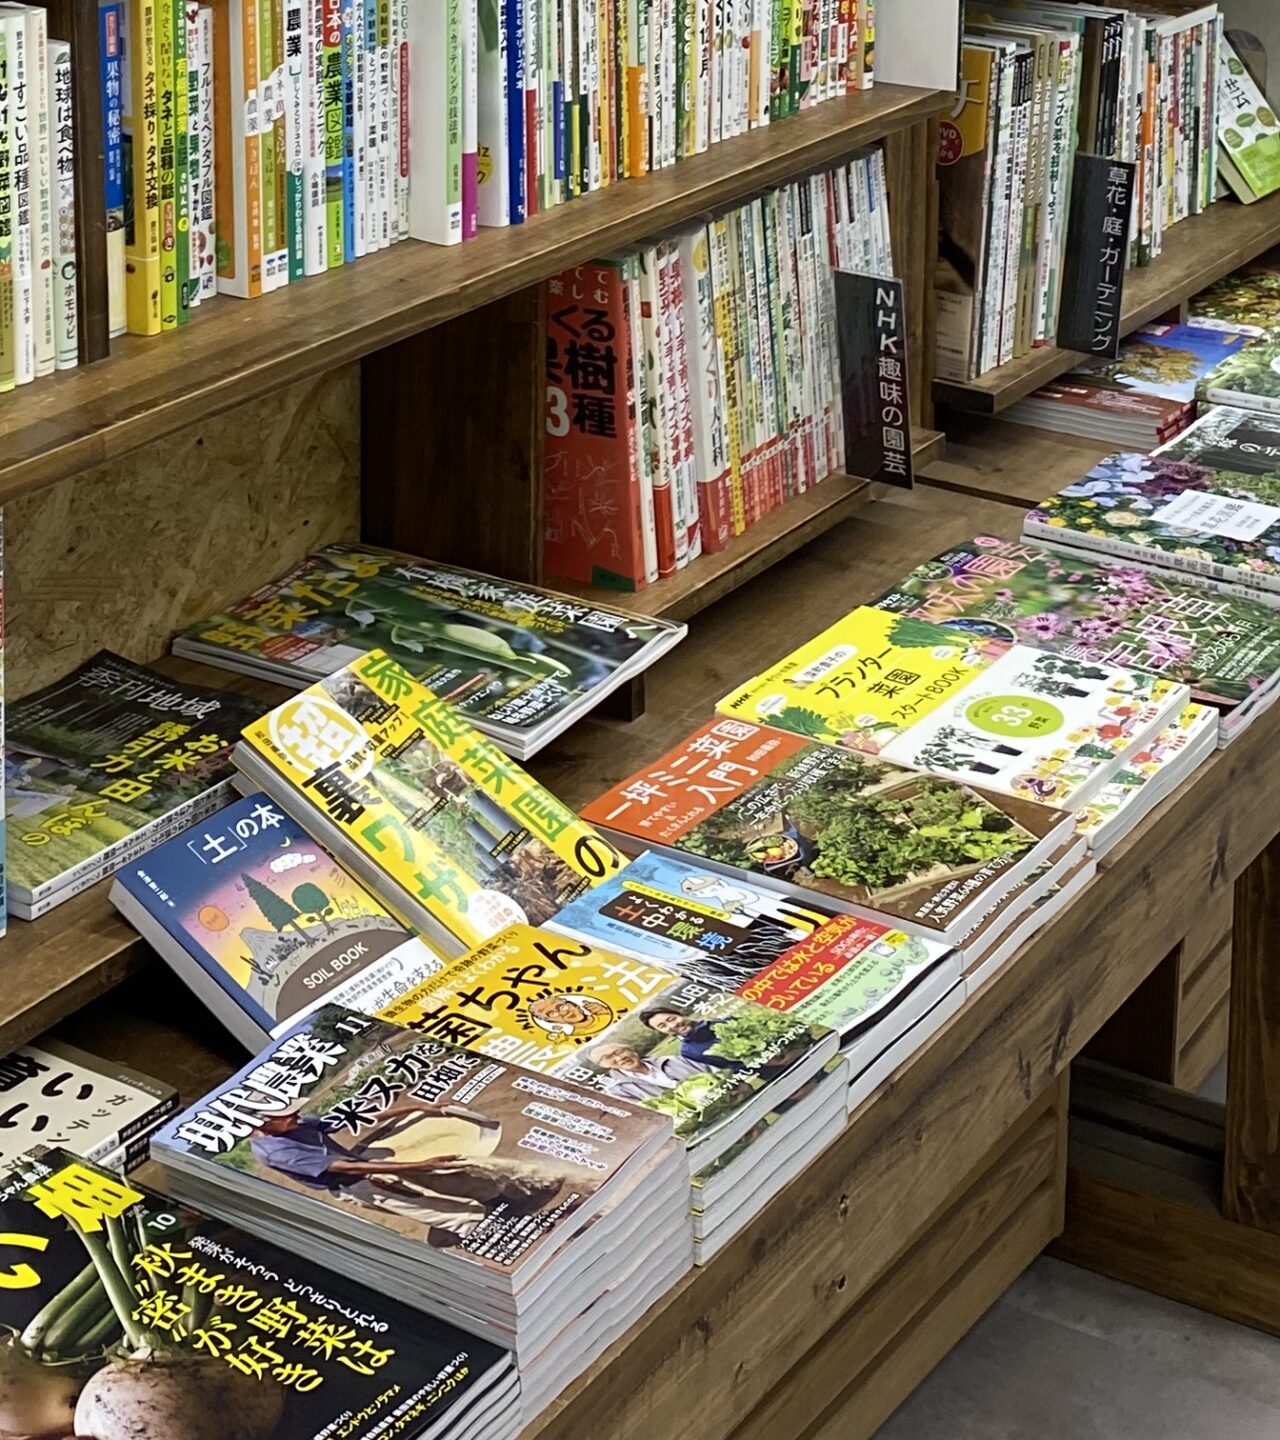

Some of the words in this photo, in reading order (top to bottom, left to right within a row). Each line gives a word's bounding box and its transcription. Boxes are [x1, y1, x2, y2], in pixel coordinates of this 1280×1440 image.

[1091, 167, 1129, 352] 草花・庭・ガーデニング
[876, 287, 907, 476] NHK趣味の園芸
[77, 666, 221, 720] 季刊地域
[814, 647, 895, 701] プランター
[880, 667, 921, 701] 菜園
[891, 665, 968, 722] スタートBOOK
[991, 703, 1033, 728] 33
[90, 721, 194, 773] 誘引力
[361, 653, 621, 878] 家庭菜園の
[603, 720, 758, 823] 一坪ミニ菜園
[21, 734, 228, 847] お米と田んぼの
[698, 755, 758, 804] 入門
[187, 801, 286, 866] 「土」の本
[614, 902, 734, 952] 土中環境
[628, 894, 704, 926] よくわかる
[302, 962, 336, 991] SOIL
[332, 941, 370, 973] BOOK
[175, 1029, 347, 1154] 現代農業
[336, 1018, 370, 1038] 11
[321, 1041, 447, 1136] 米ヌカを
[410, 1050, 481, 1105] 田畑に
[147, 1213, 177, 1232] 10
[132, 1242, 396, 1375] 秋まき野菜は
